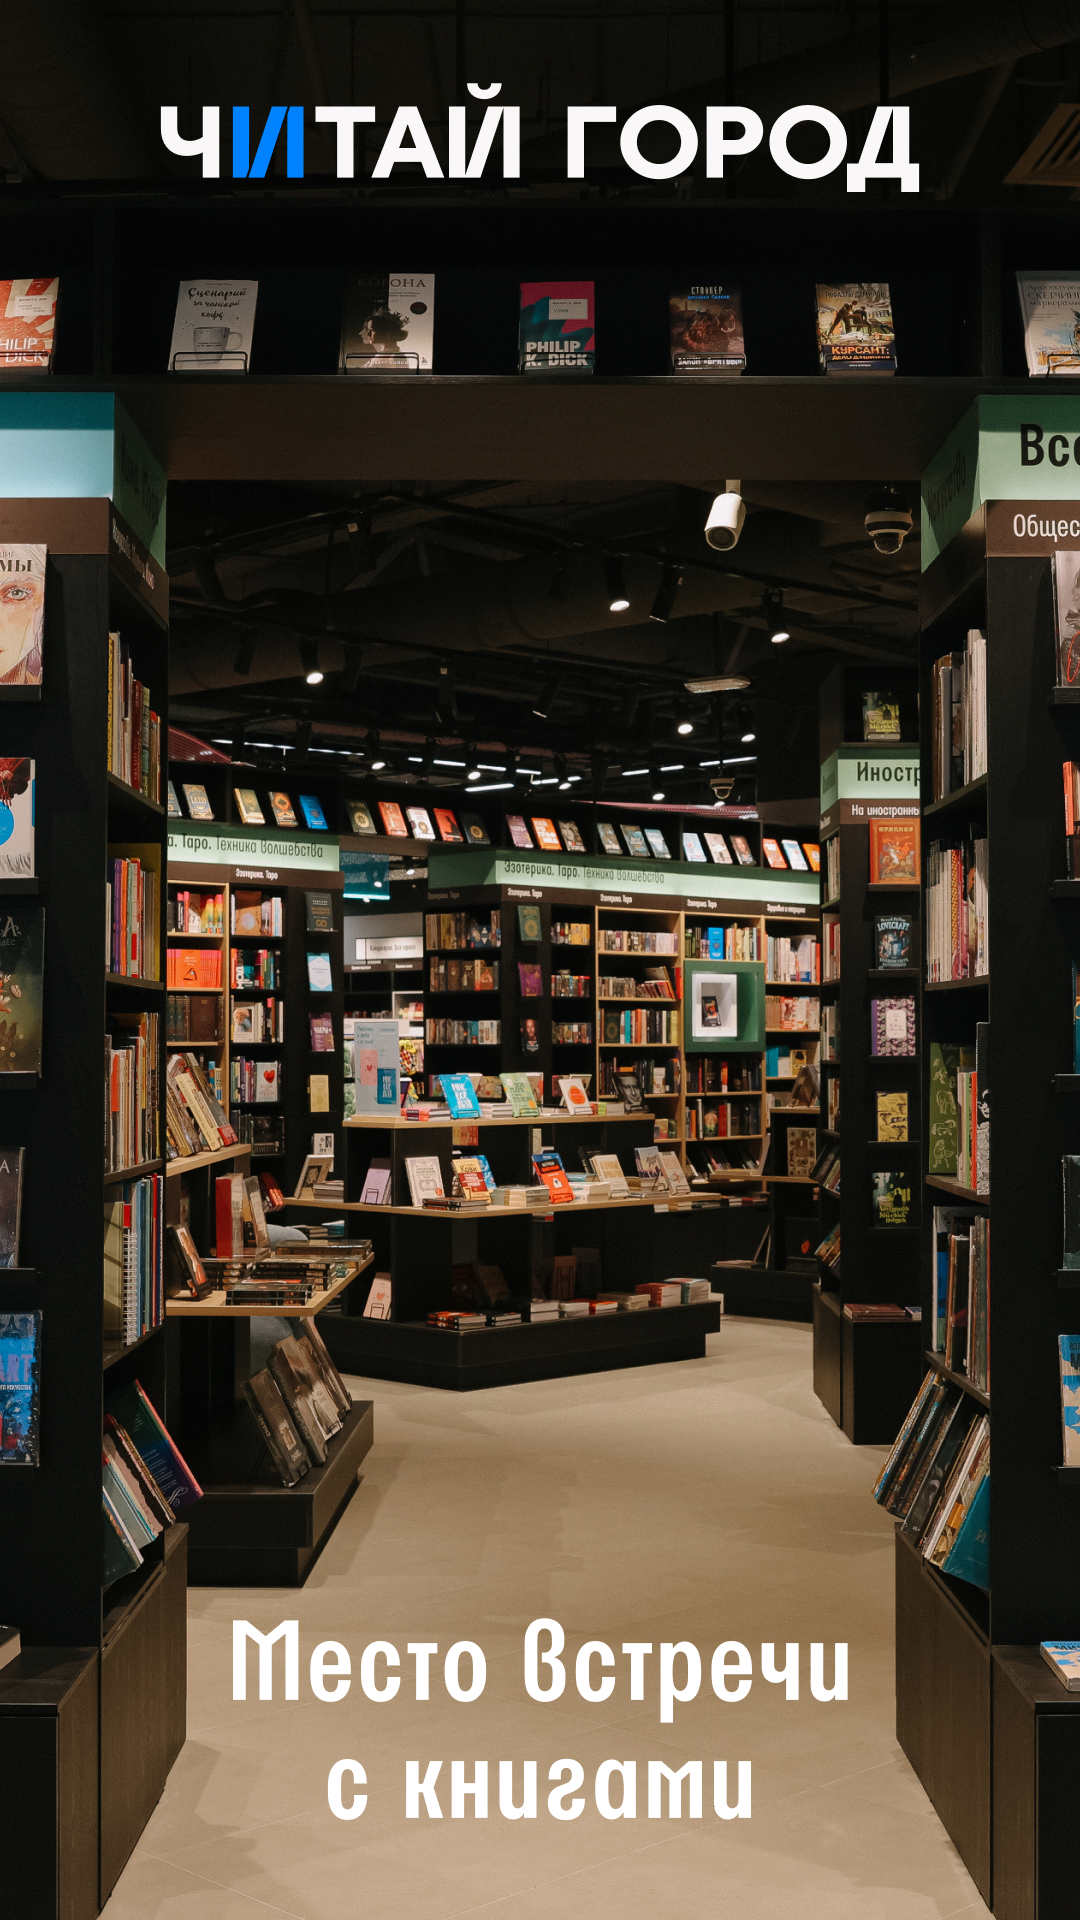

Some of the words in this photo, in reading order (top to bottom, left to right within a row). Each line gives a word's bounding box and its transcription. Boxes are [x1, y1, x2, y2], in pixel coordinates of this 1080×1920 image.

[526, 340, 581, 353] PHILIP
[831, 346, 890, 355] КУРСАНТ:
[548, 353, 589, 366] DICK
[851, 804, 864, 816] На
[182, 833, 212, 852] Таро.
[216, 837, 257, 853] Техника
[265, 870, 278, 880] Таро
[504, 859, 555, 878] Эзотерика.
[557, 863, 580, 880] Таро.
[583, 866, 614, 880] Техника
[877, 921, 910, 931] LOVECRAFT
